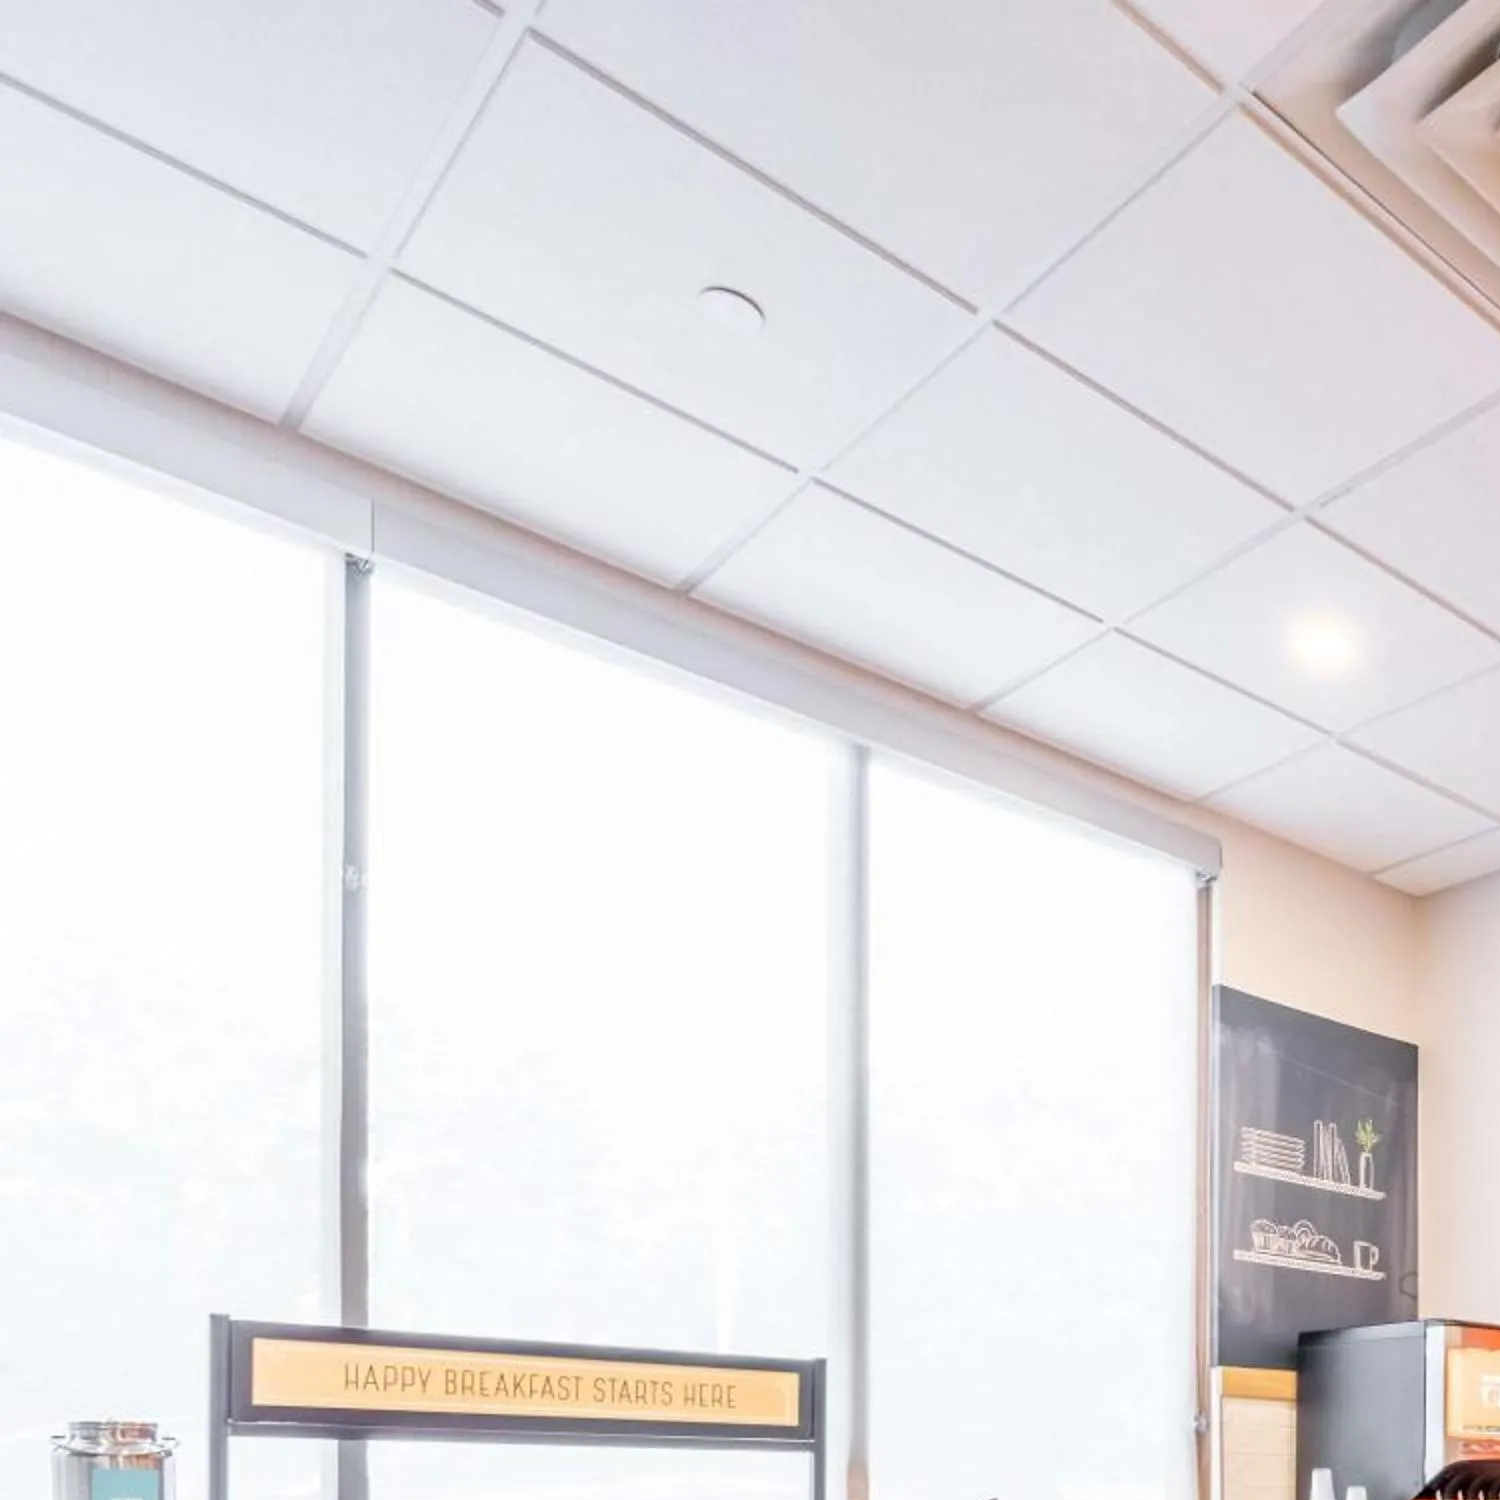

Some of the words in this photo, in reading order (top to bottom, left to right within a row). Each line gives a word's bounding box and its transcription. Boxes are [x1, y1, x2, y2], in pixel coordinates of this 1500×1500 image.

[344, 1363, 432, 1394] HAPPY
[443, 1368, 583, 1401] BREAKFAST
[592, 1376, 674, 1408] STARTS
[682, 1383, 737, 1410] HERE
